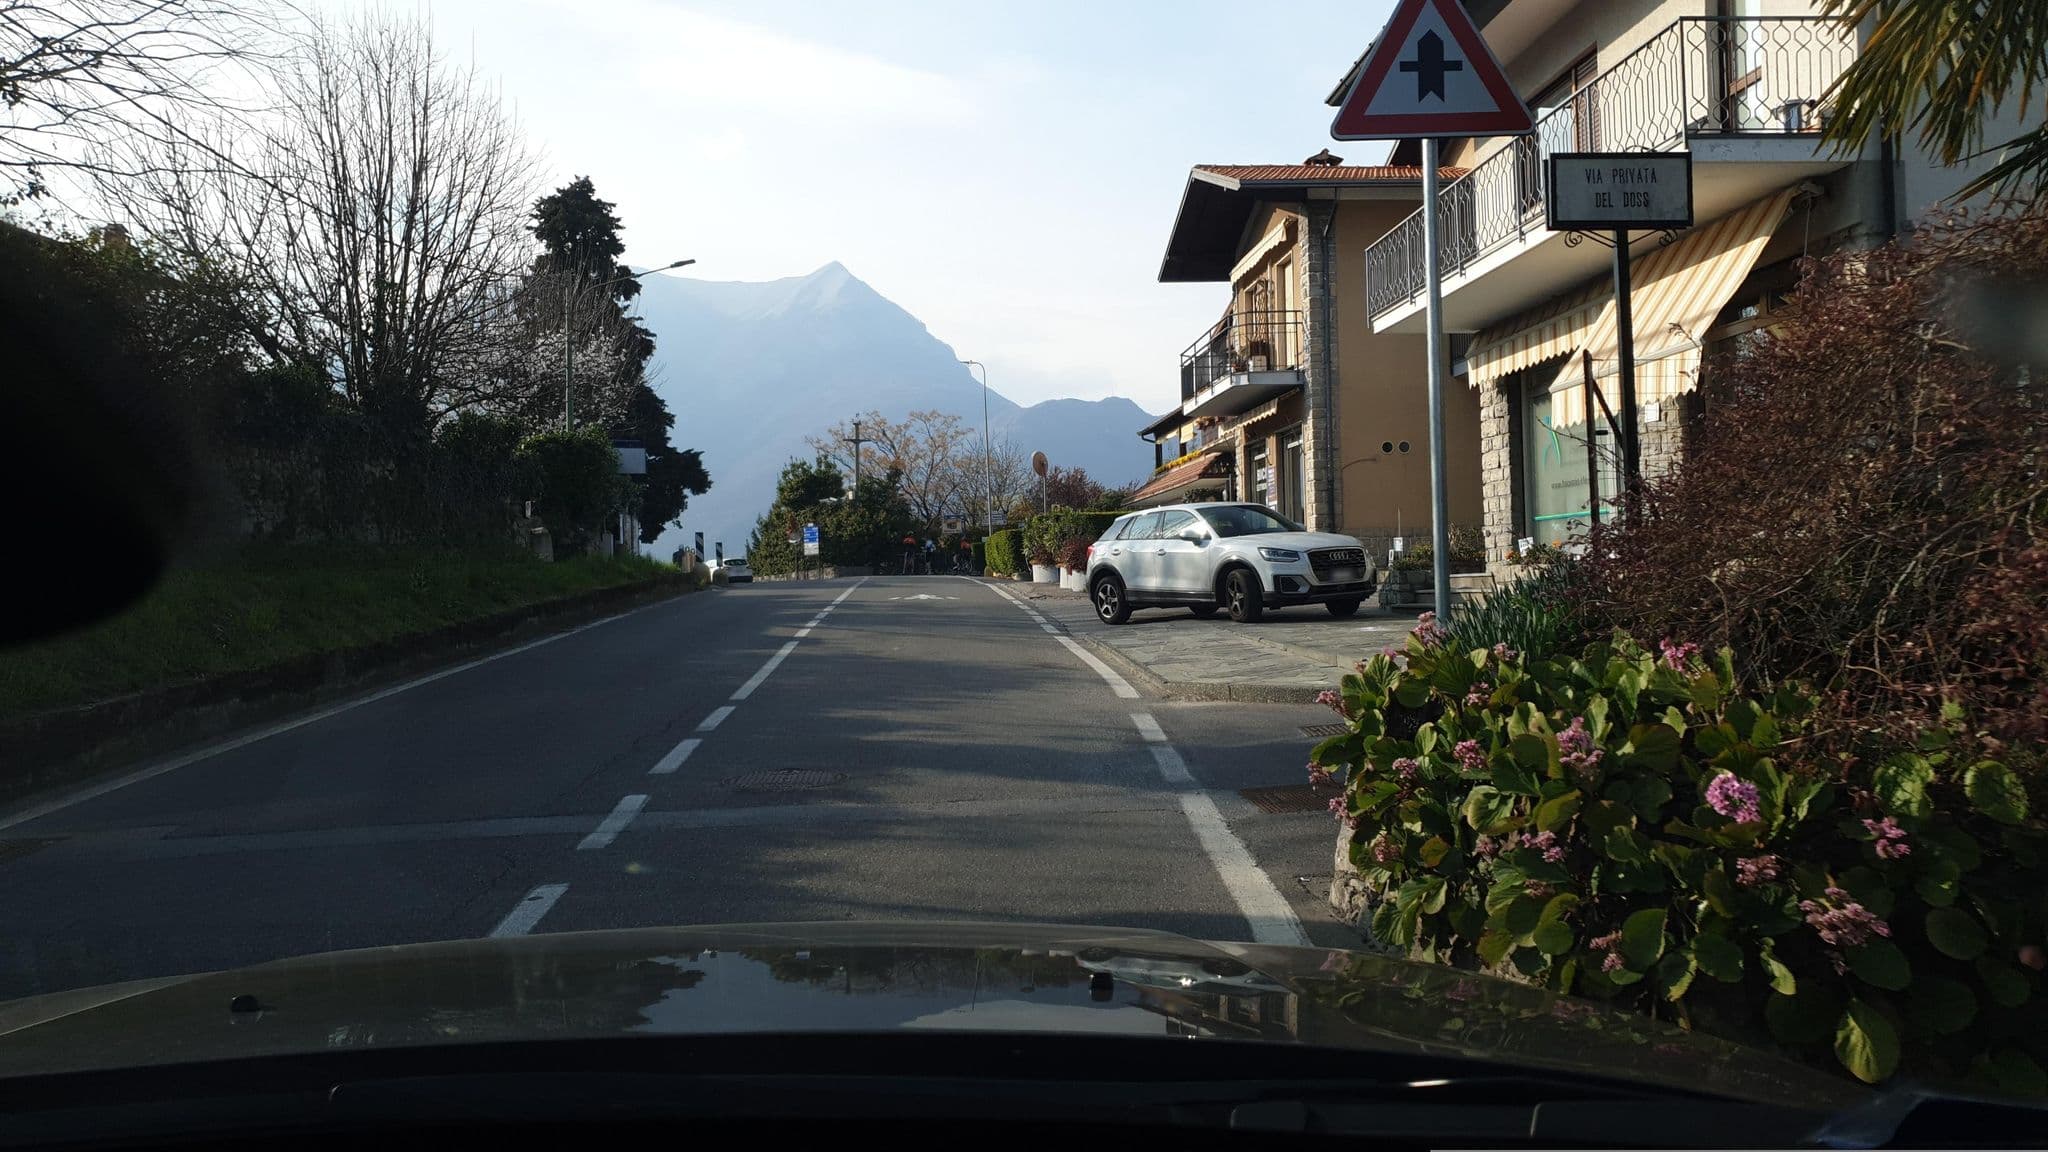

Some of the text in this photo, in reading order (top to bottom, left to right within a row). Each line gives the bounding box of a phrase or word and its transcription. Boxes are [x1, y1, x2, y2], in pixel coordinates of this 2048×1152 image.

[1585, 167, 1657, 185] VIA PRIVATA
[1595, 191, 1650, 208] DEL DOSS
